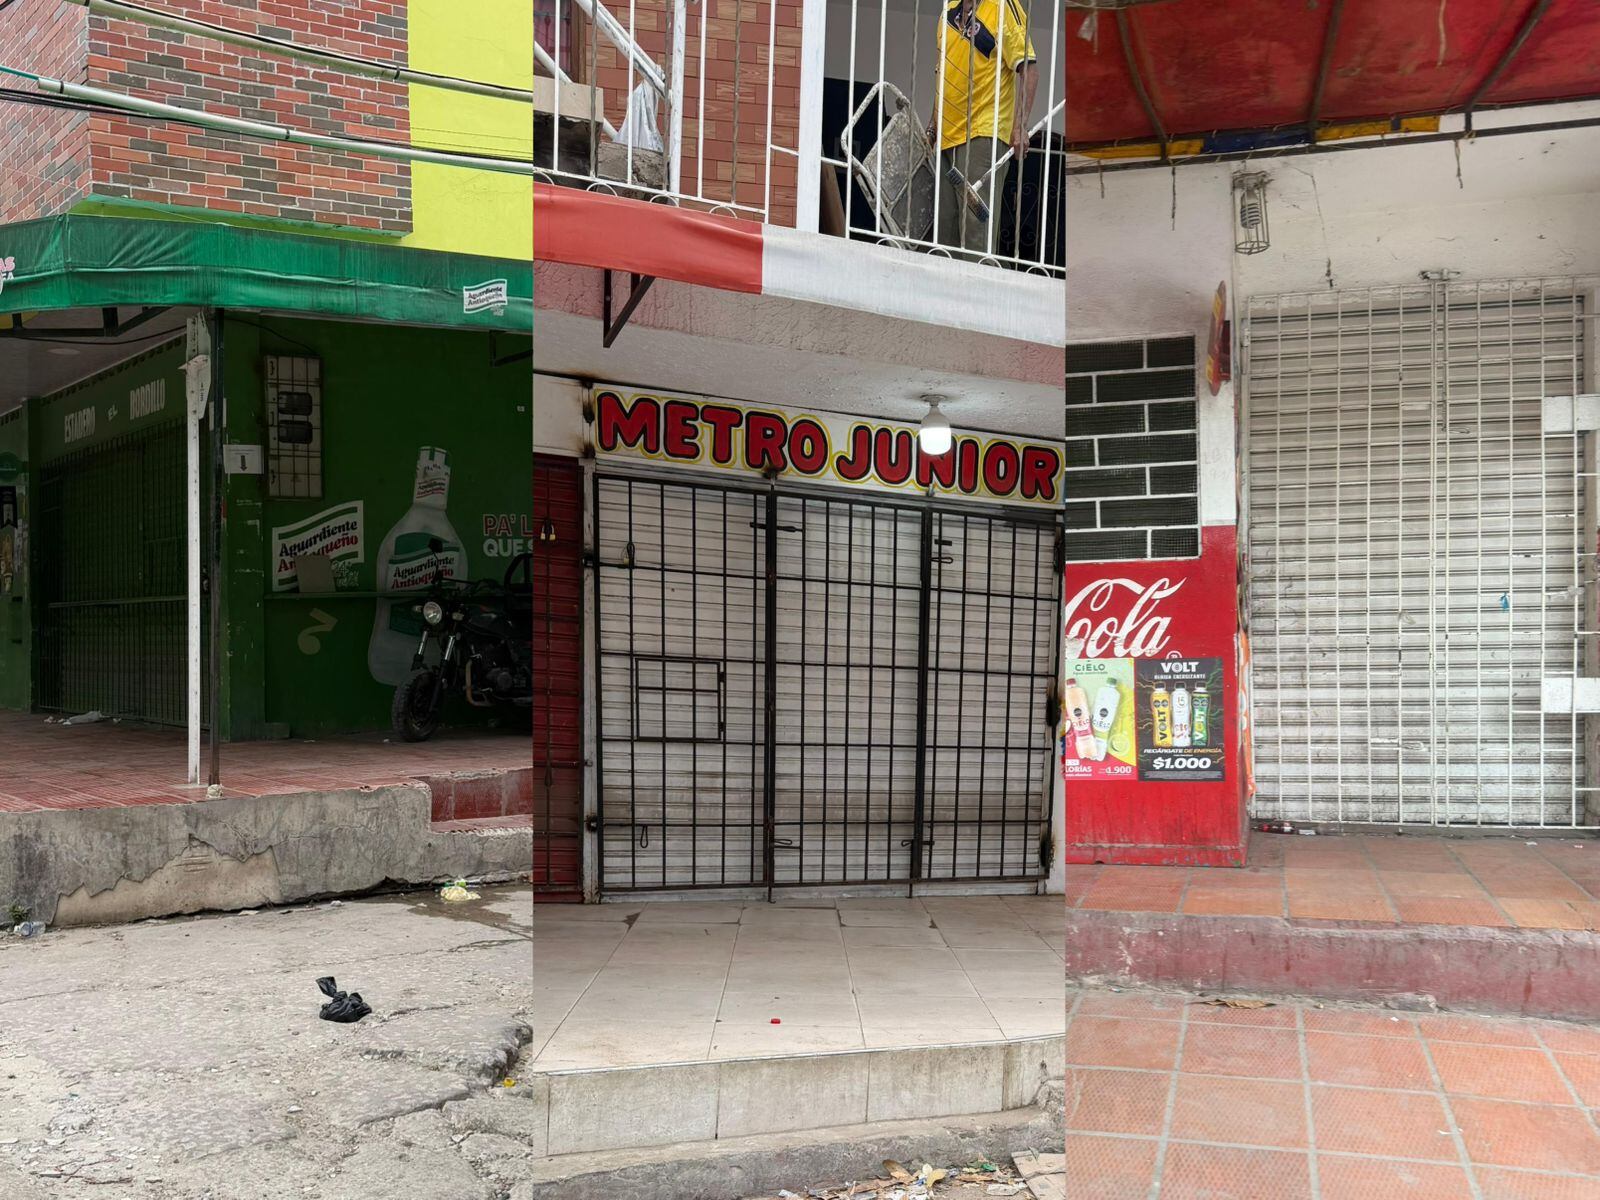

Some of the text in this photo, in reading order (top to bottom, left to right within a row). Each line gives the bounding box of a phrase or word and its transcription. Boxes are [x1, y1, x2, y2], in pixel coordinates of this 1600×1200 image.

[597, 391, 1060, 499] METRO JUNIOR
[279, 520, 358, 558] Aguardiente
[483, 538, 524, 557] QUE
[1074, 662, 1106, 672] CIELO
[1160, 662, 1199, 673] VOLT
[1158, 710, 1168, 741] VOLT
[1152, 756, 1212, 769] $1.000
